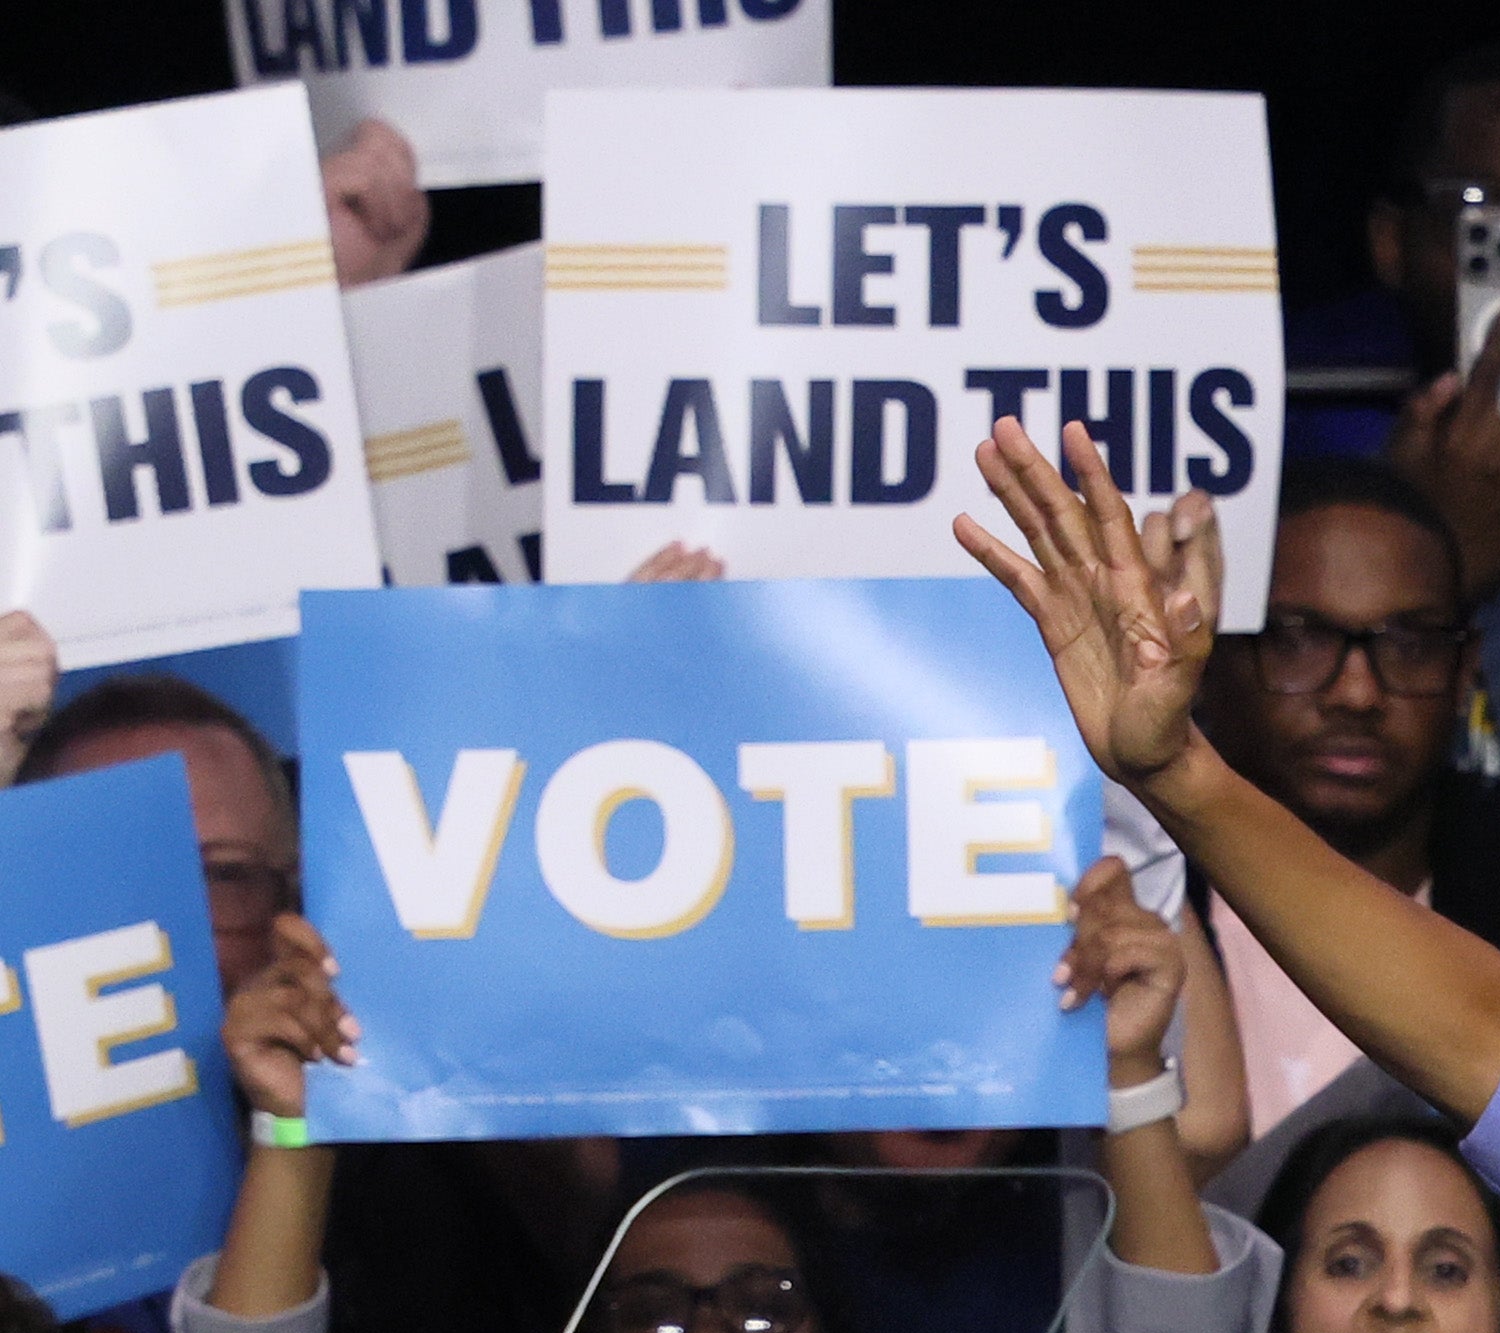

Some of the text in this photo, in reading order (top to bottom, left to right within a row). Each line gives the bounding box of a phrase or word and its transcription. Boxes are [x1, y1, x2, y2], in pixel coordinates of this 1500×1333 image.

[757, 202, 1109, 328] LET'S
[571, 377, 937, 505] LAND
[965, 366, 1257, 498] THIS
[342, 736, 1072, 939] VOTE
